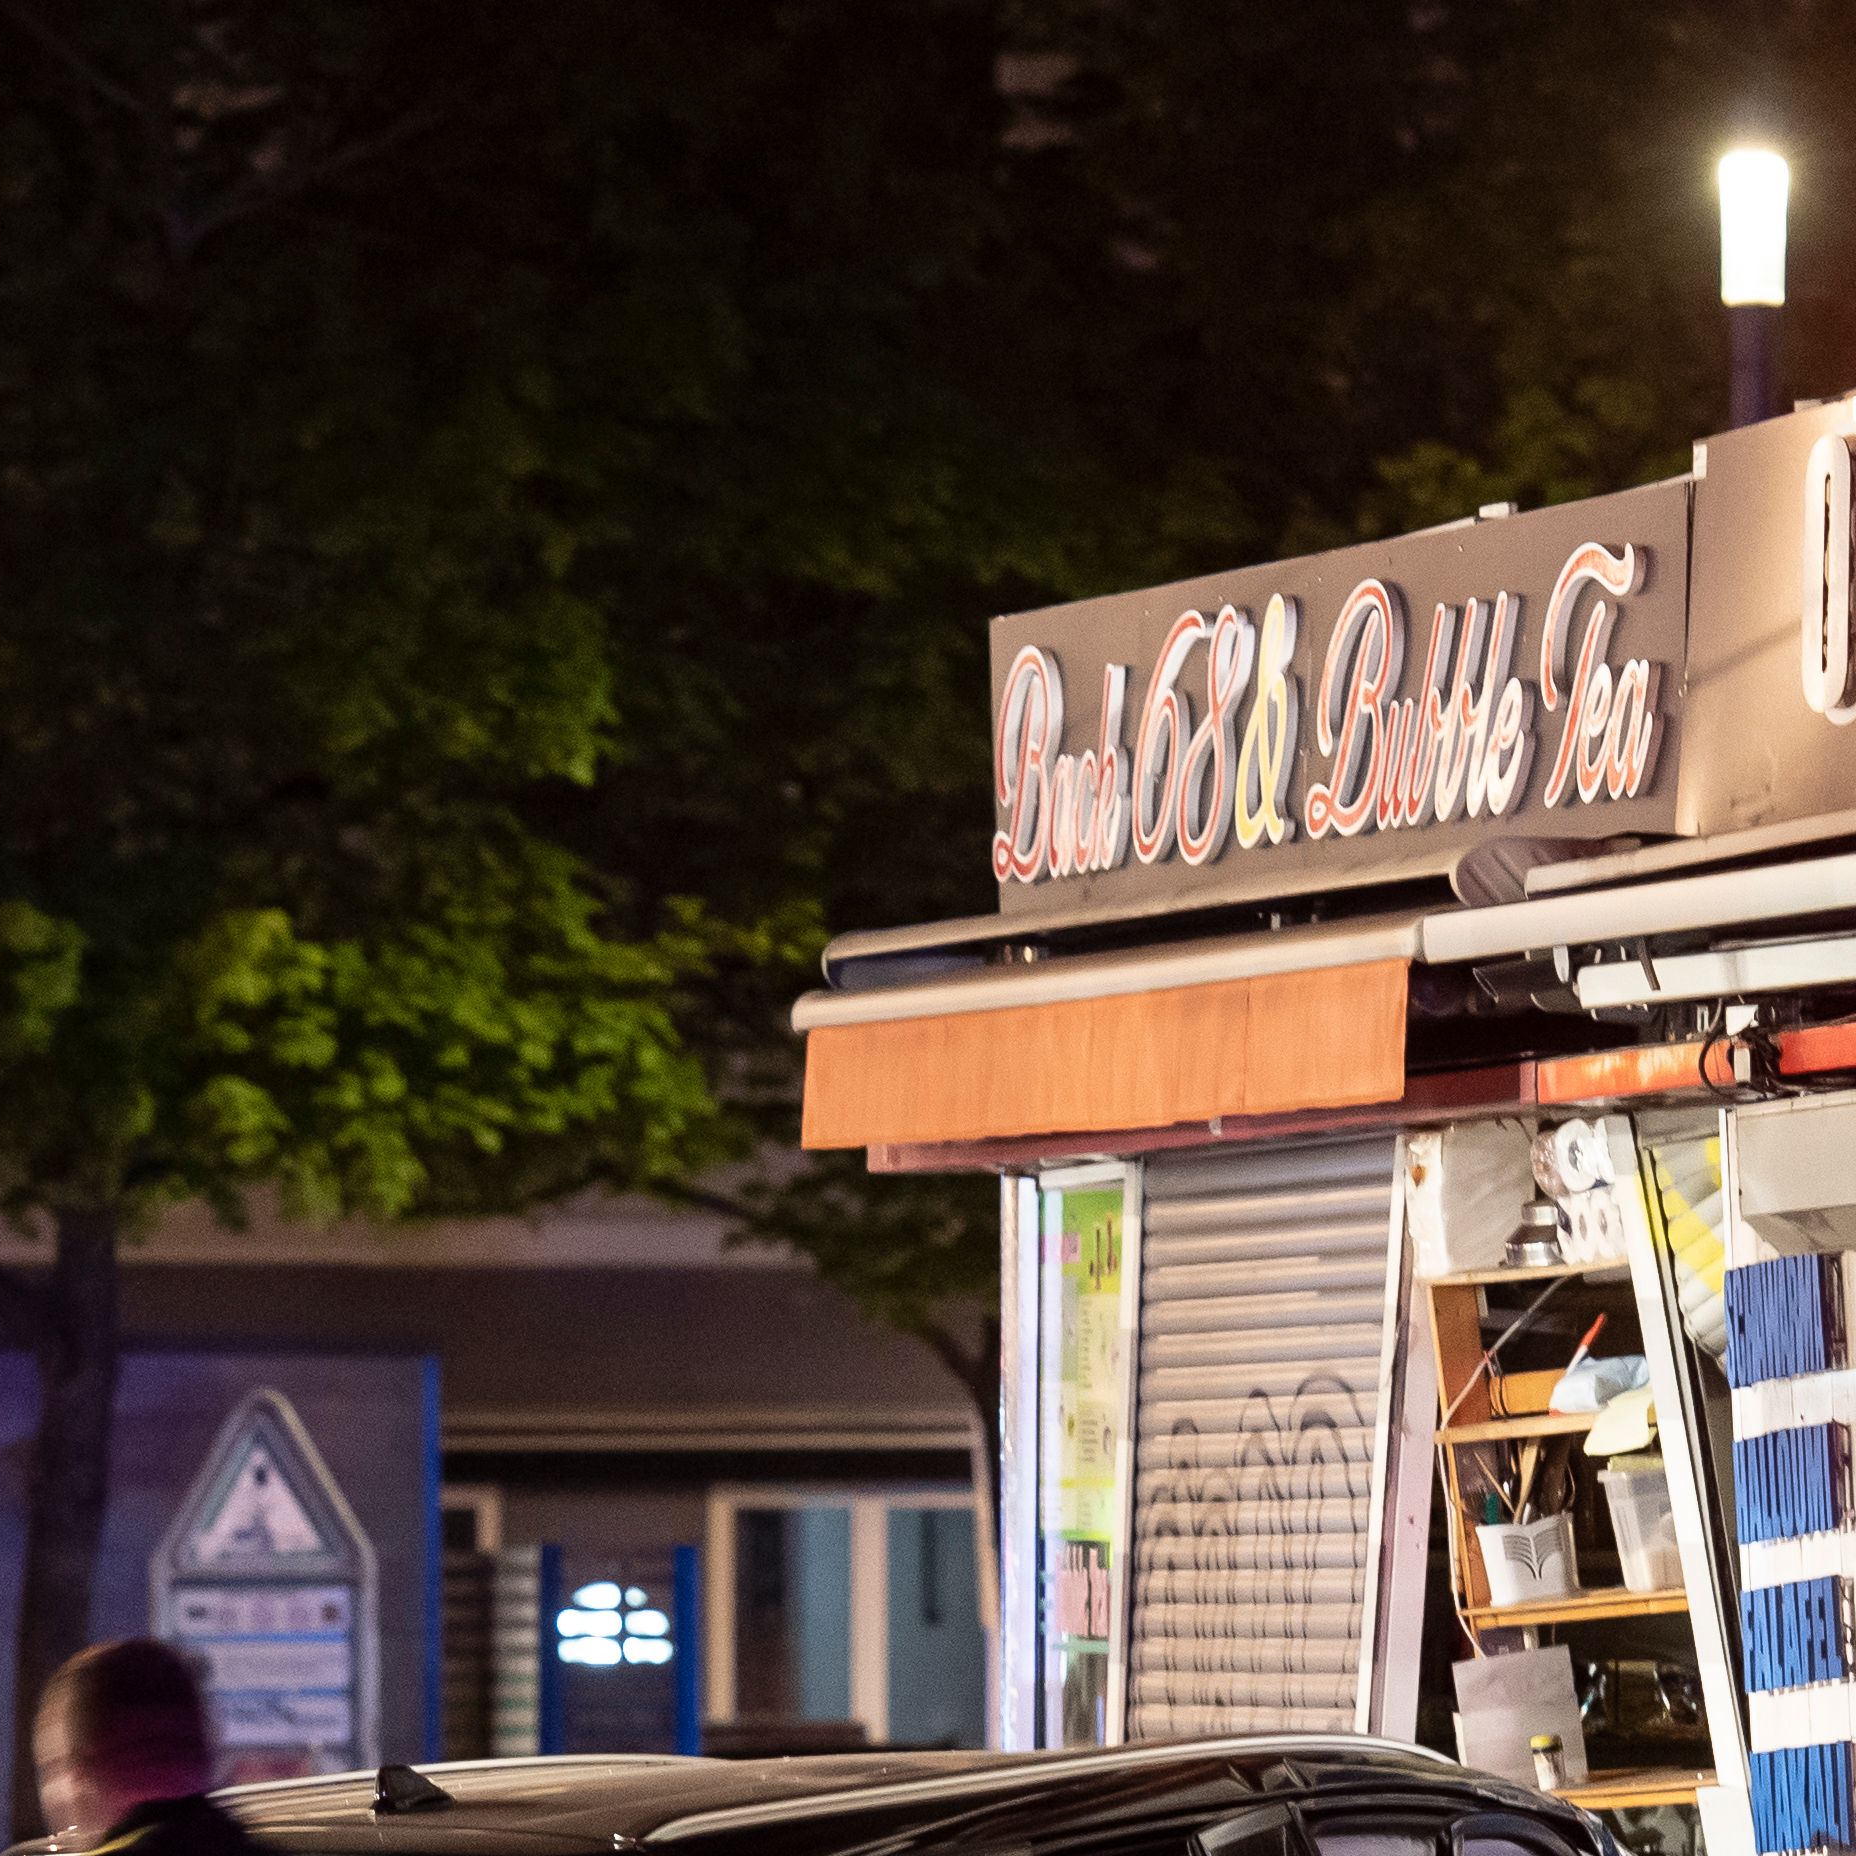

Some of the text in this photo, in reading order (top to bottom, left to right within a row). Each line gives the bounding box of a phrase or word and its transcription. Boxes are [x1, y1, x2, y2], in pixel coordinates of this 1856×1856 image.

[1305, 578, 1538, 840] Bubble
[1542, 542, 1662, 808] Tea
[1732, 1422, 1835, 1545] HALLOUMI
[1740, 1574, 1842, 1694] FALAFEL
